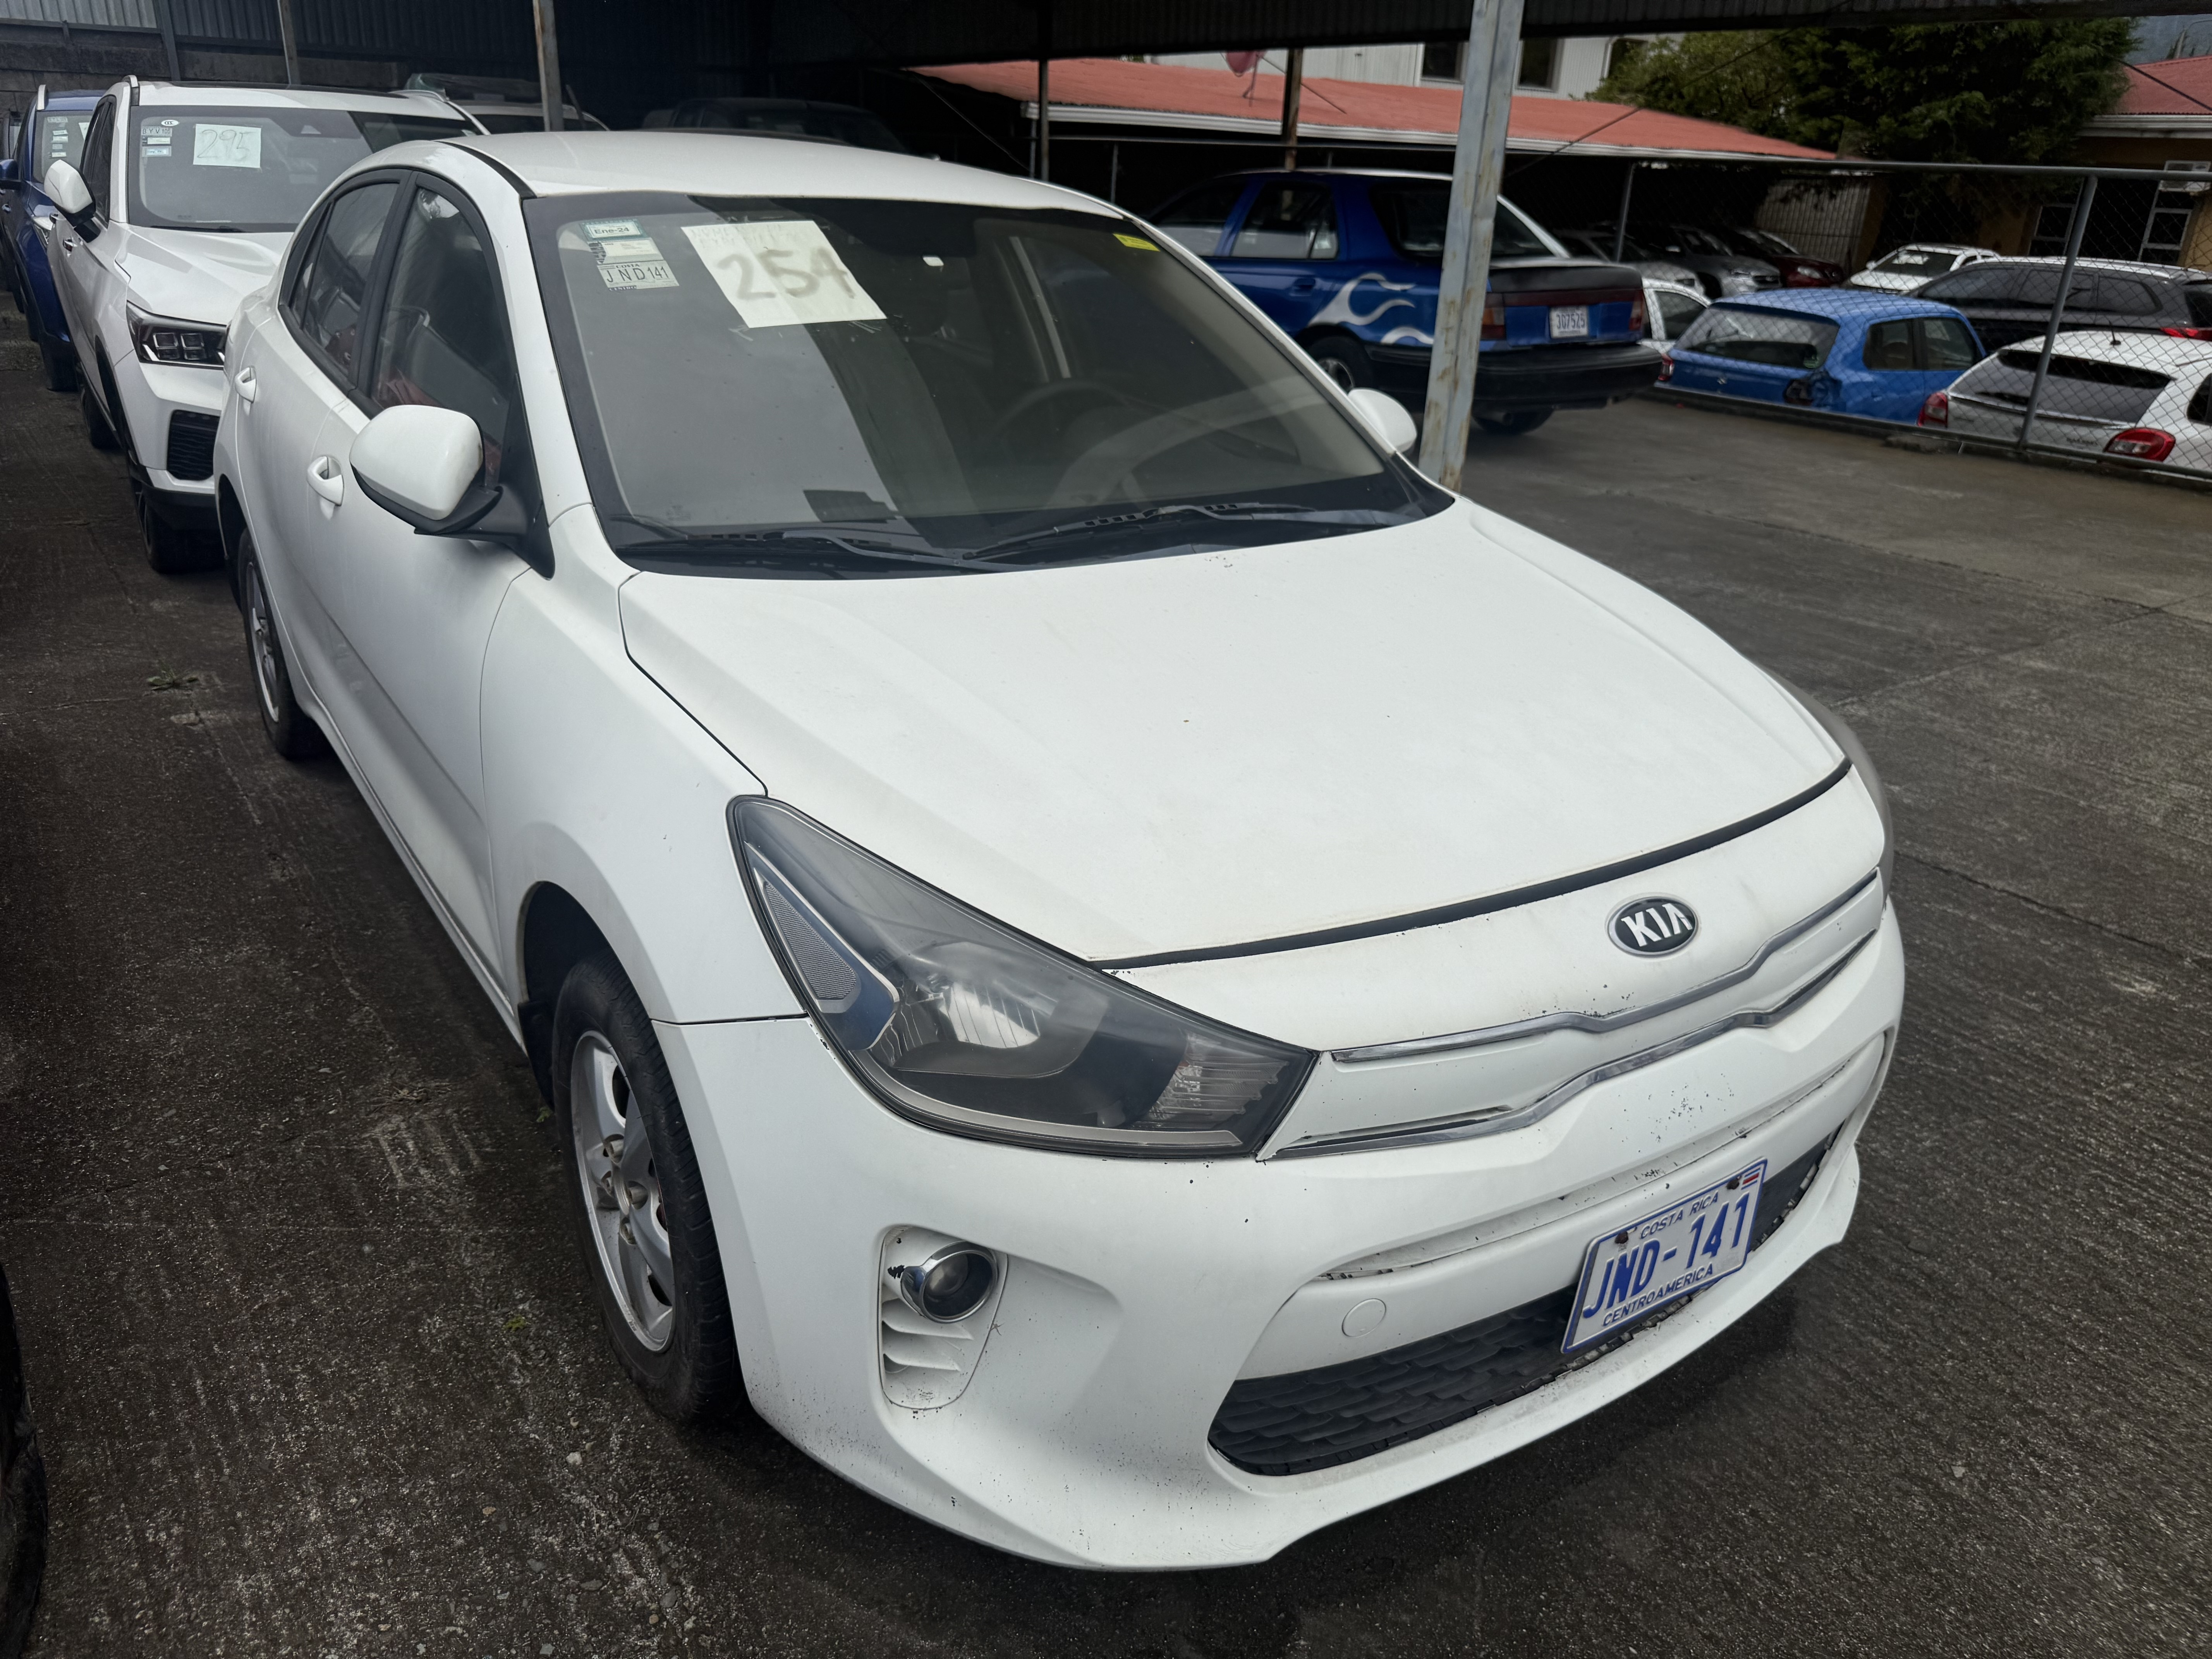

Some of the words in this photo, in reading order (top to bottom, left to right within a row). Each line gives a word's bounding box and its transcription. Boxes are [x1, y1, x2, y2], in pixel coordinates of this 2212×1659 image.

[647, 266, 669, 279] 141
[716, 247, 855, 300] 254
[1621, 903, 1693, 947] KIA
[1640, 1209, 1683, 1239] COSTA
[1688, 1192, 1719, 1216] RICA
[1582, 1192, 1750, 1319] JND-141
[1603, 1263, 1713, 1326] CENTROAMERICA
